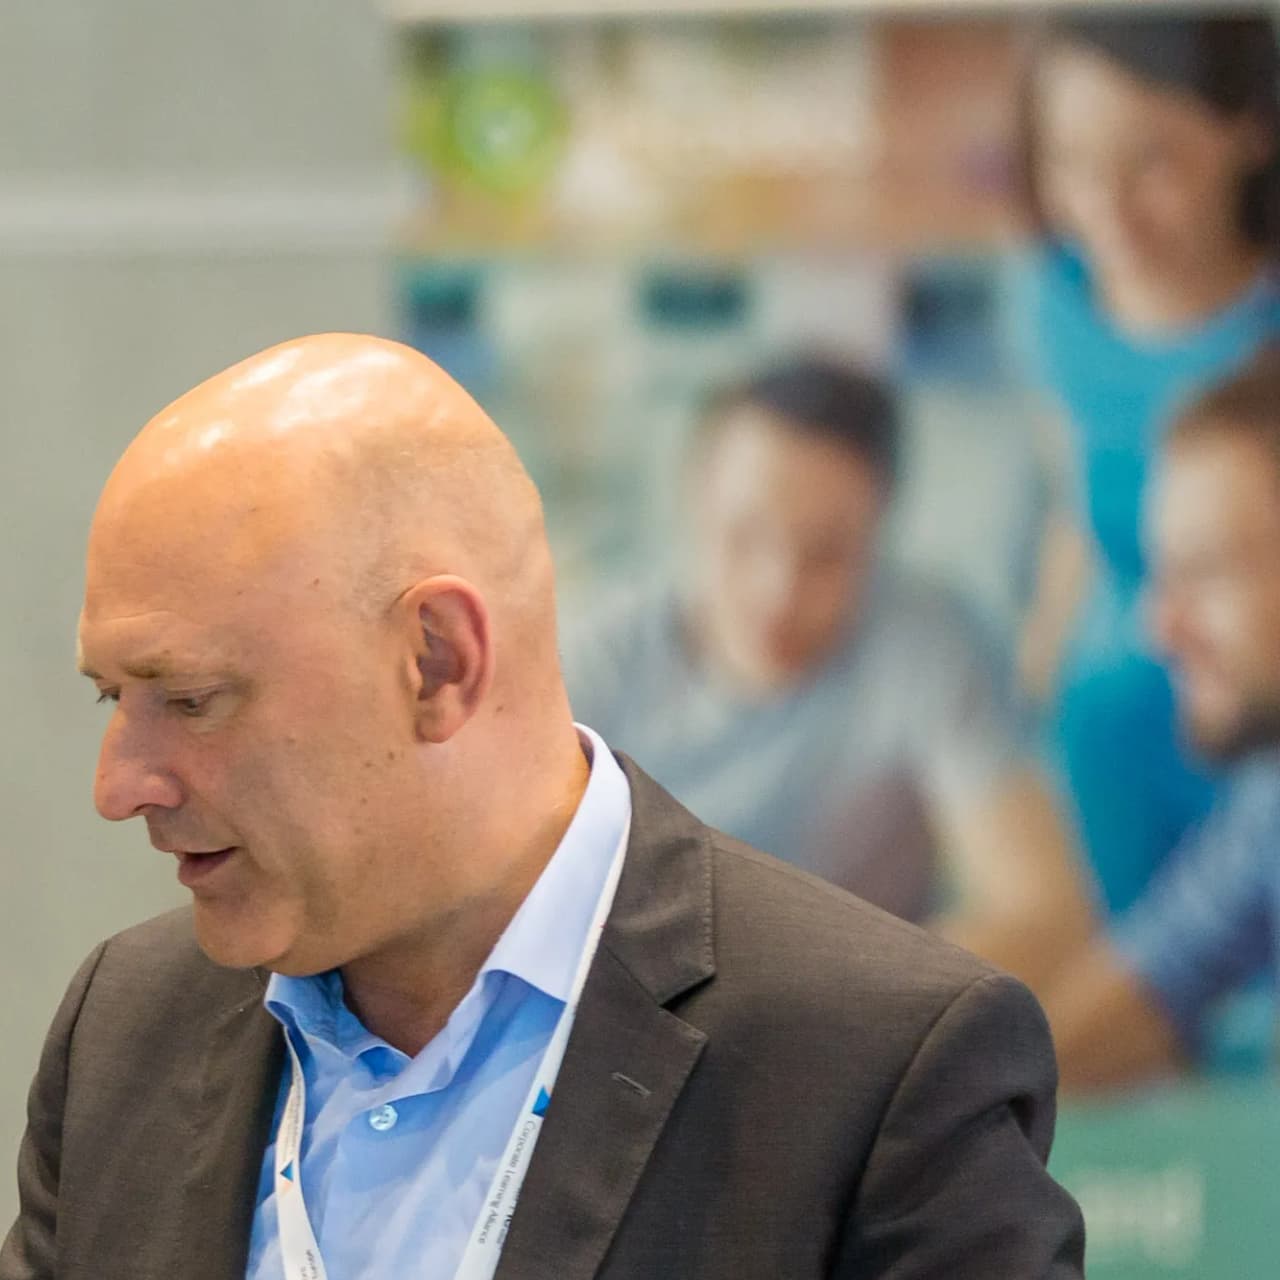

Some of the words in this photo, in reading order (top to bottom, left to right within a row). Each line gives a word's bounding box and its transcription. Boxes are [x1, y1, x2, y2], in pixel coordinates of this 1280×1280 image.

[510, 1120, 537, 1168] Corporate
[489, 1170, 516, 1208] Learning
[478, 1209, 499, 1244] Alliance
